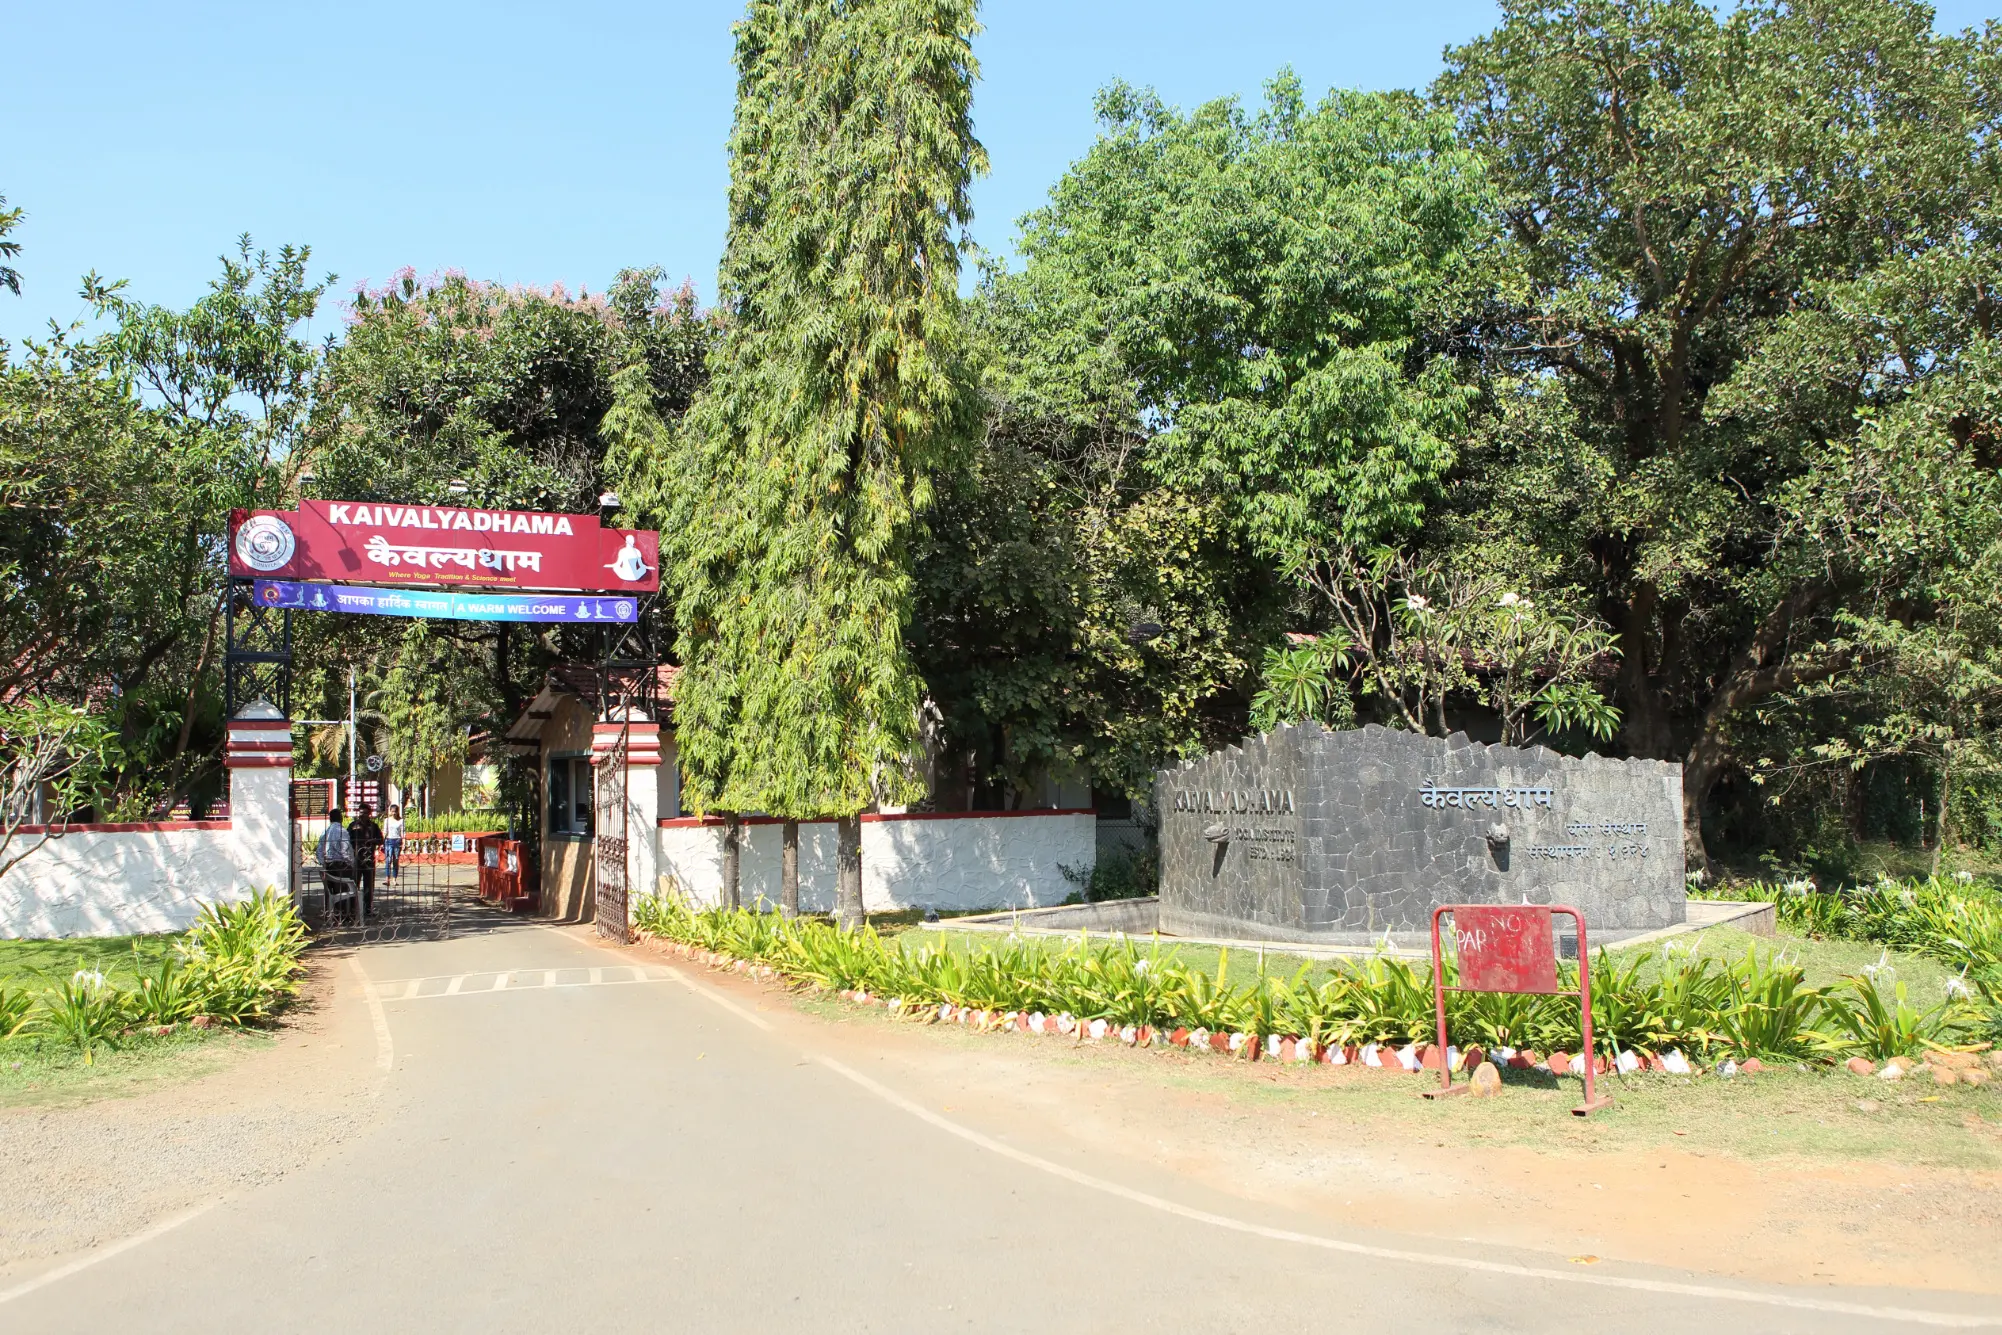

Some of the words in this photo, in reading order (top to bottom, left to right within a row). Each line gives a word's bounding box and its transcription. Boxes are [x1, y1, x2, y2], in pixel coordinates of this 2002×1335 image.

[329, 504, 574, 536] KAIVALYADHAMA
[363, 535, 543, 572] कैवल्यधाम
[388, 571, 411, 579] Where
[413, 572, 431, 580] Yoga
[434, 573, 464, 581] Tradition
[472, 575, 498, 583] Science
[337, 594, 375, 607] आपका
[377, 595, 411, 609] हार्दिक
[413, 600, 448, 612] स्वागत
[456, 605, 466, 613] A
[468, 604, 504, 614] WARM
[507, 604, 566, 615] WELCOME
[1418, 777, 1554, 811] कैवल्यधाम
[1597, 819, 1648, 838] संस्थान
[1490, 914, 1521, 932] NO
